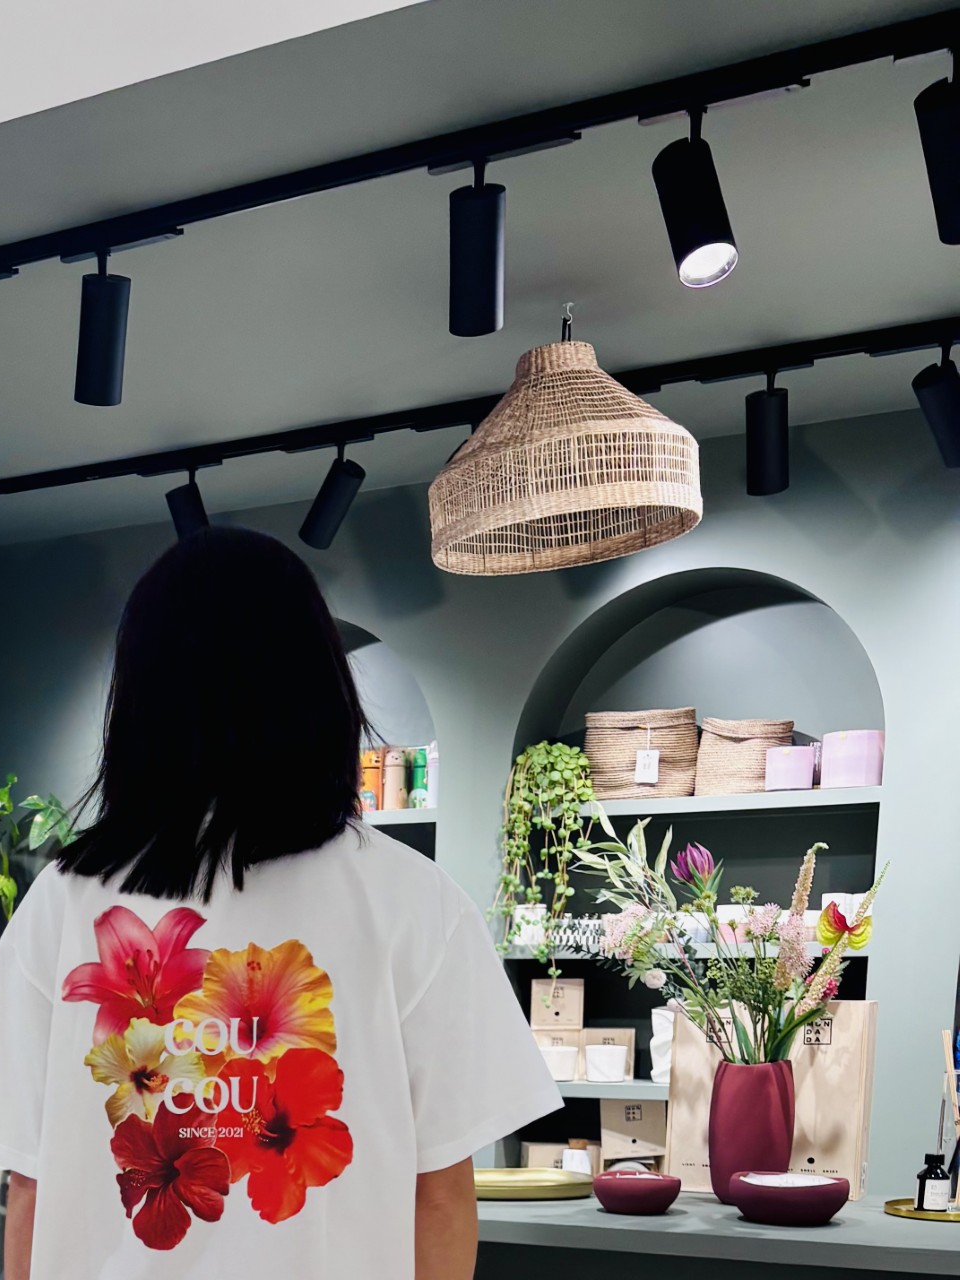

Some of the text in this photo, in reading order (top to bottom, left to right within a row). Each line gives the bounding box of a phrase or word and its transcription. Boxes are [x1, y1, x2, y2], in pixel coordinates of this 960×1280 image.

[164, 1016, 260, 1056] COU
[163, 1076, 259, 1115] COU
[178, 1127, 244, 1138] SINCE 2021
